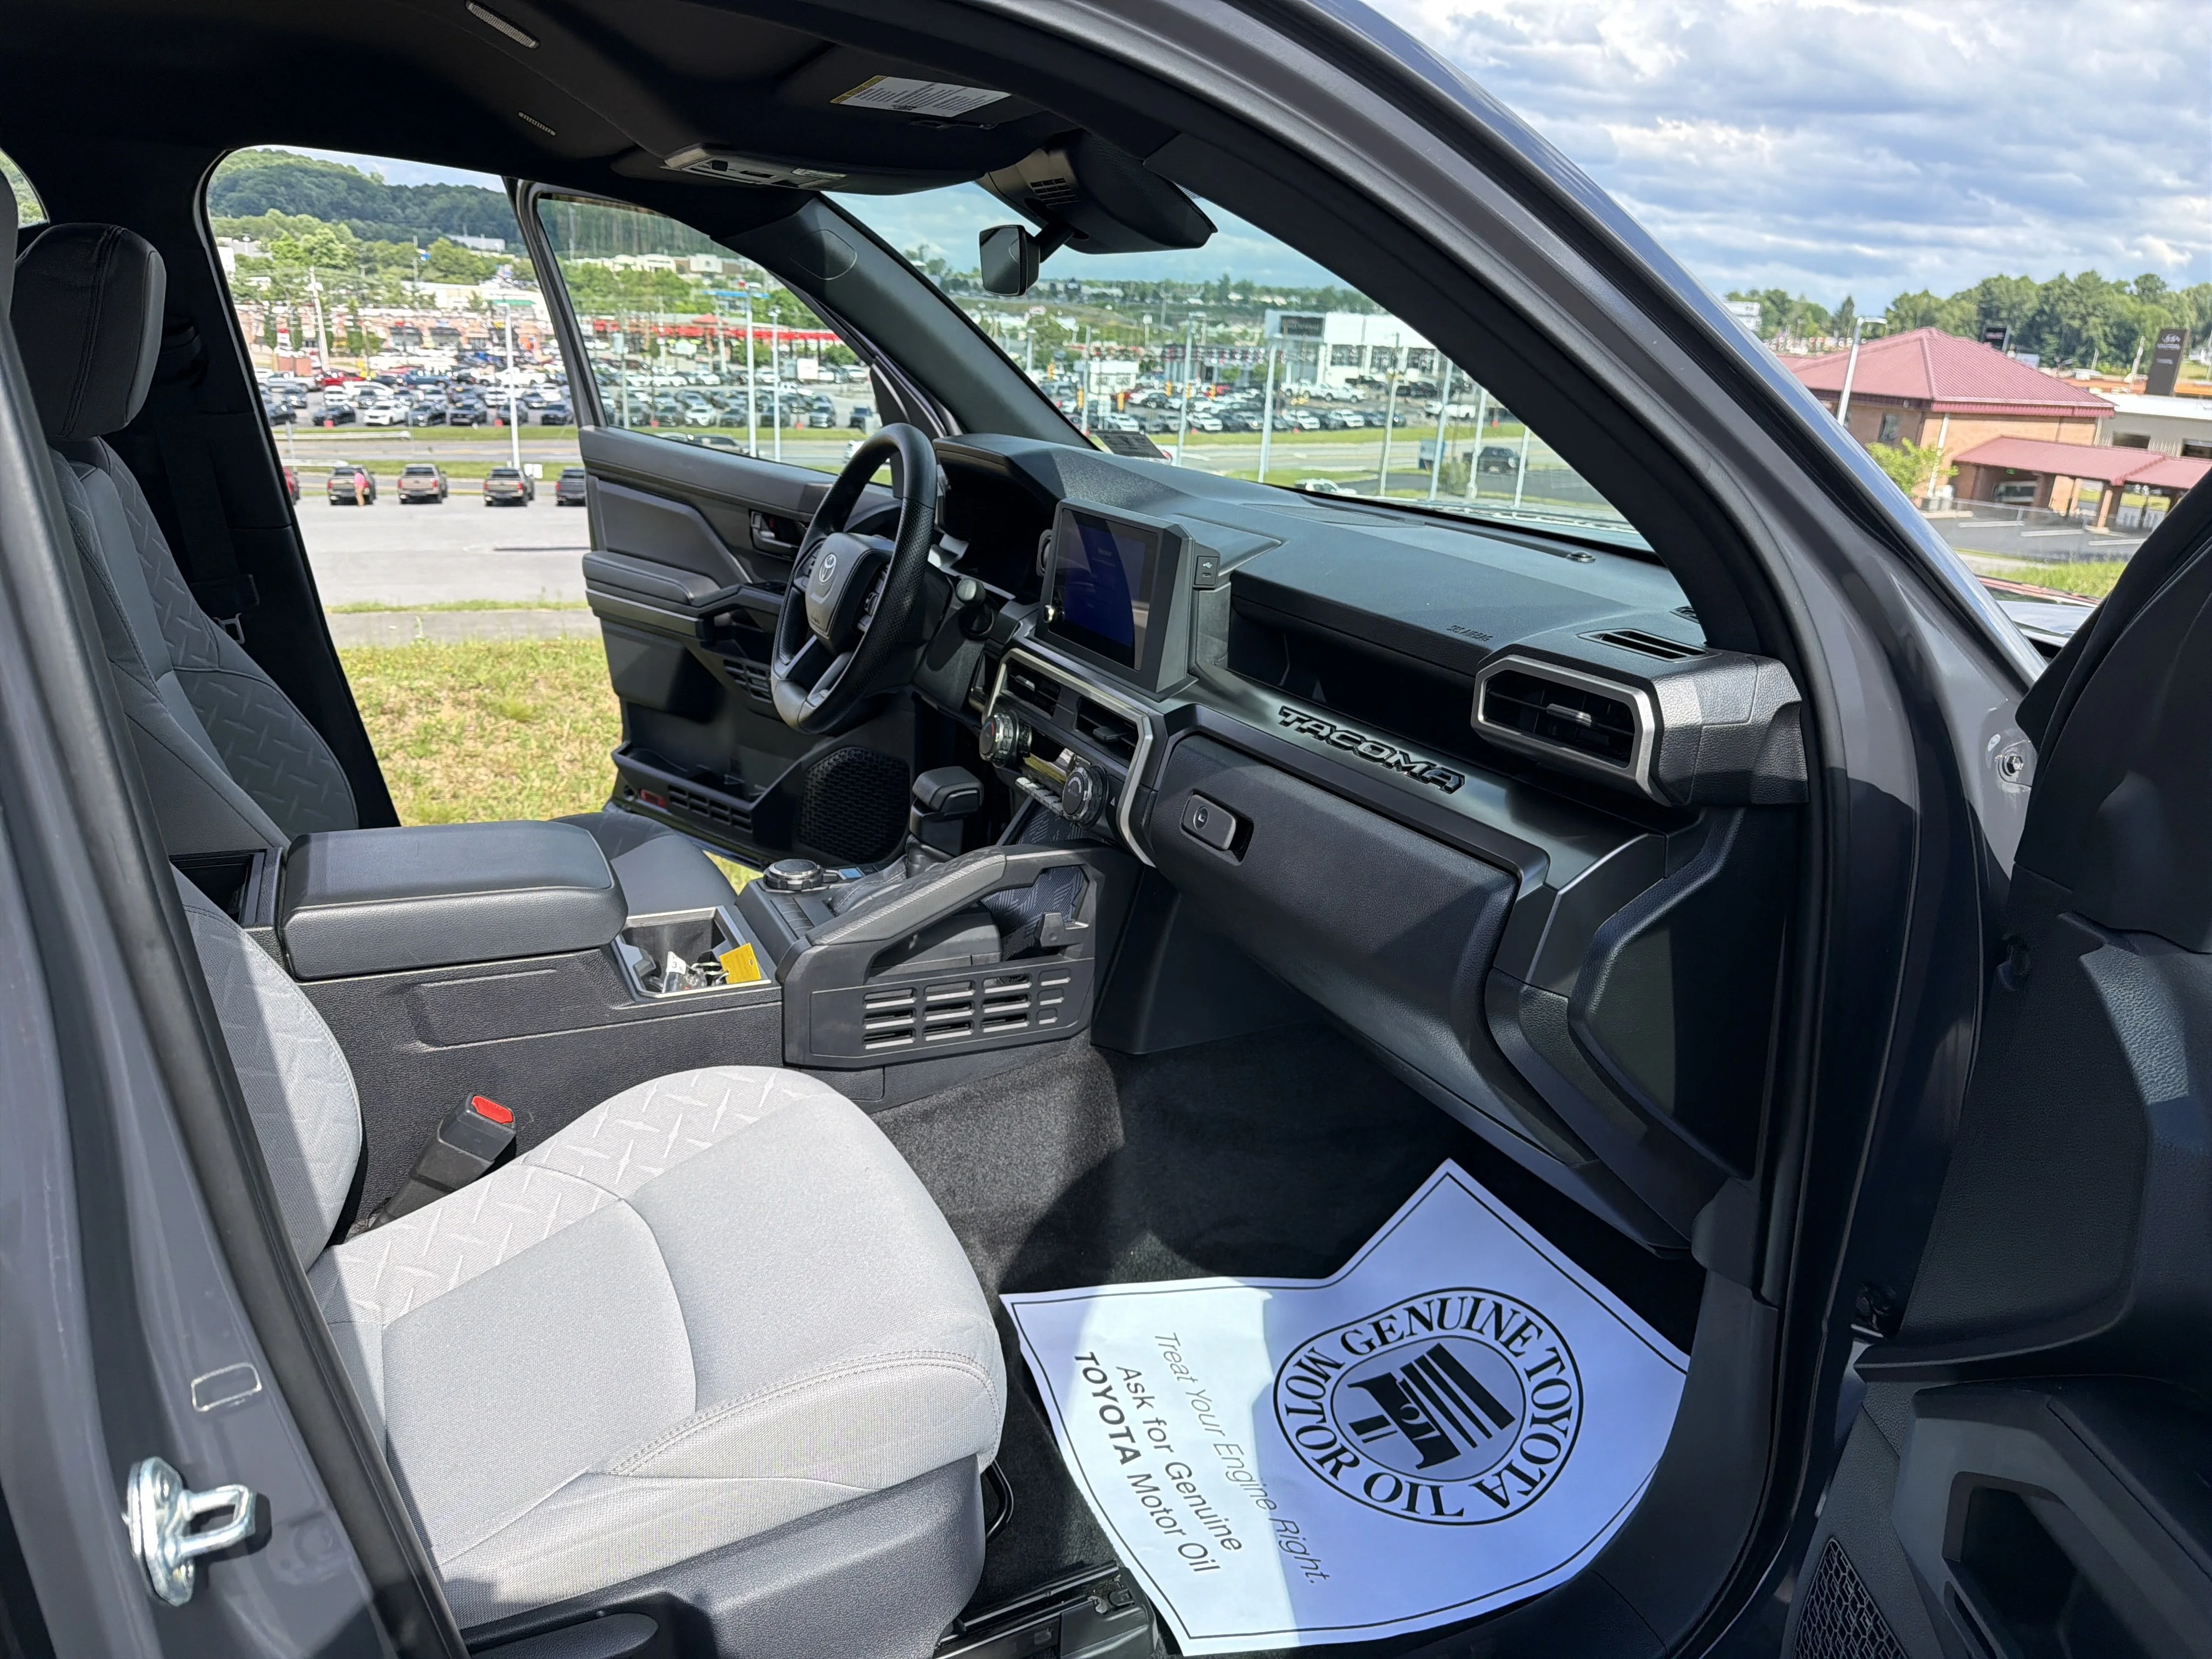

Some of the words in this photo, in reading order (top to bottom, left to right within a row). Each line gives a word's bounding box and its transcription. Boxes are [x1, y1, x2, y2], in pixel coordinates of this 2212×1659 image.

[1278, 705, 1465, 794] TACOMA
[1074, 1351, 1142, 1465] TOYOTA
[1126, 1472, 1187, 1536] Motor
[1177, 1542, 1221, 1572] Oil
[1115, 1365, 1155, 1410] Ask
[1142, 1417, 1175, 1453] for
[1164, 1461, 1243, 1551] Genuine
[1154, 1332, 1199, 1384] Treat
[1185, 1389, 1226, 1437] Your
[1212, 1443, 1278, 1511] Engine
[1268, 1517, 1330, 1584] Right.
[1284, 1347, 1361, 1481] MOTOR
[1363, 1471, 1465, 1517] OIL
[1340, 1296, 1543, 1358] GENUINE
[1469, 1346, 1573, 1510] TOYOTA
